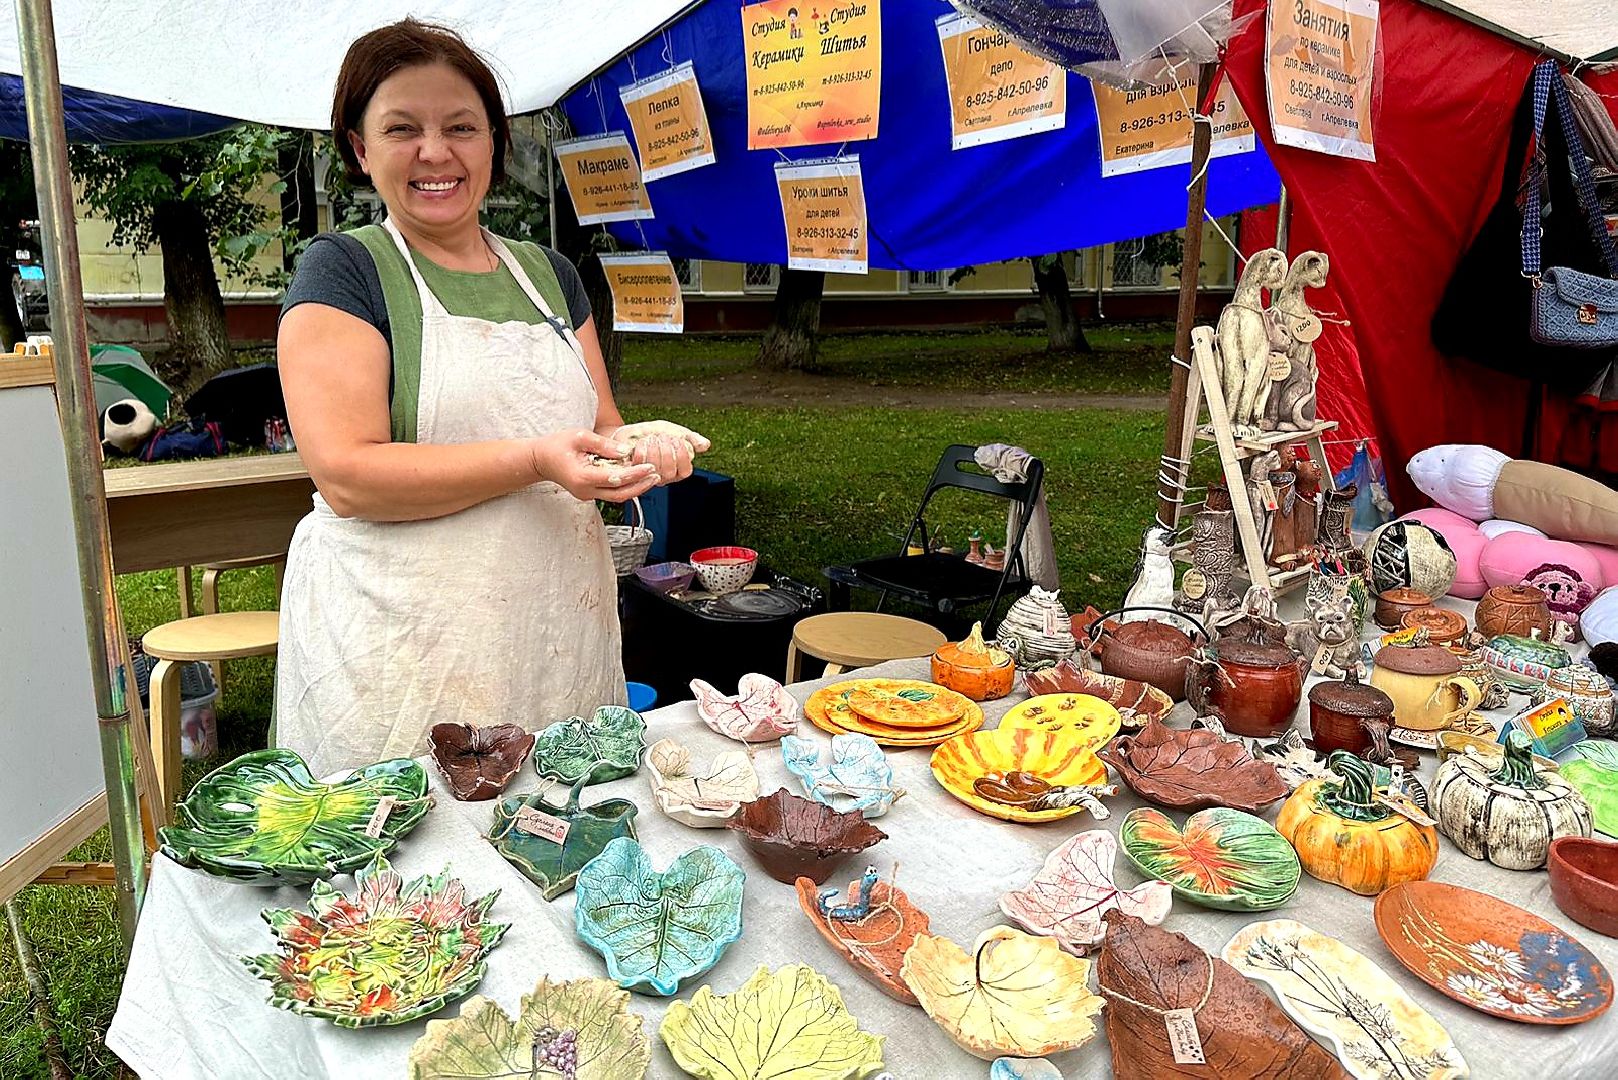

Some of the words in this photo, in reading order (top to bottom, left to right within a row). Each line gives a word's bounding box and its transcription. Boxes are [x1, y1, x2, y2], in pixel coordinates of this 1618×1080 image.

[830, 3, 867, 25] Студия
[1293, 1, 1350, 41] Занятия
[752, 17, 786, 38] Студия
[820, 34, 867, 56] Шитья
[1299, 36, 1309, 49] по
[1310, 41, 1341, 59] керамике
[752, 46, 804, 69] Керамики
[990, 60, 1013, 76] дело
[1284, 57, 1298, 68] для
[1299, 59, 1320, 75] детей
[1320, 66, 1326, 76] и
[1326, 68, 1358, 86] взрослых
[965, 76, 1049, 108] 8-925-842-50-96
[1126, 91, 1147, 105] для
[1290, 79, 1354, 110] 8-925-842-50-96
[648, 95, 680, 115] Лепка
[1007, 100, 1053, 118] г.Апрелевка
[1115, 140, 1154, 155] Екатерина
[577, 157, 629, 176] Макраме
[820, 186, 849, 198] шитья
[806, 208, 819, 219] для
[820, 207, 840, 219] детей
[797, 227, 859, 239] 8-926-313-32-45
[1296, 320, 1311, 333] 1200
